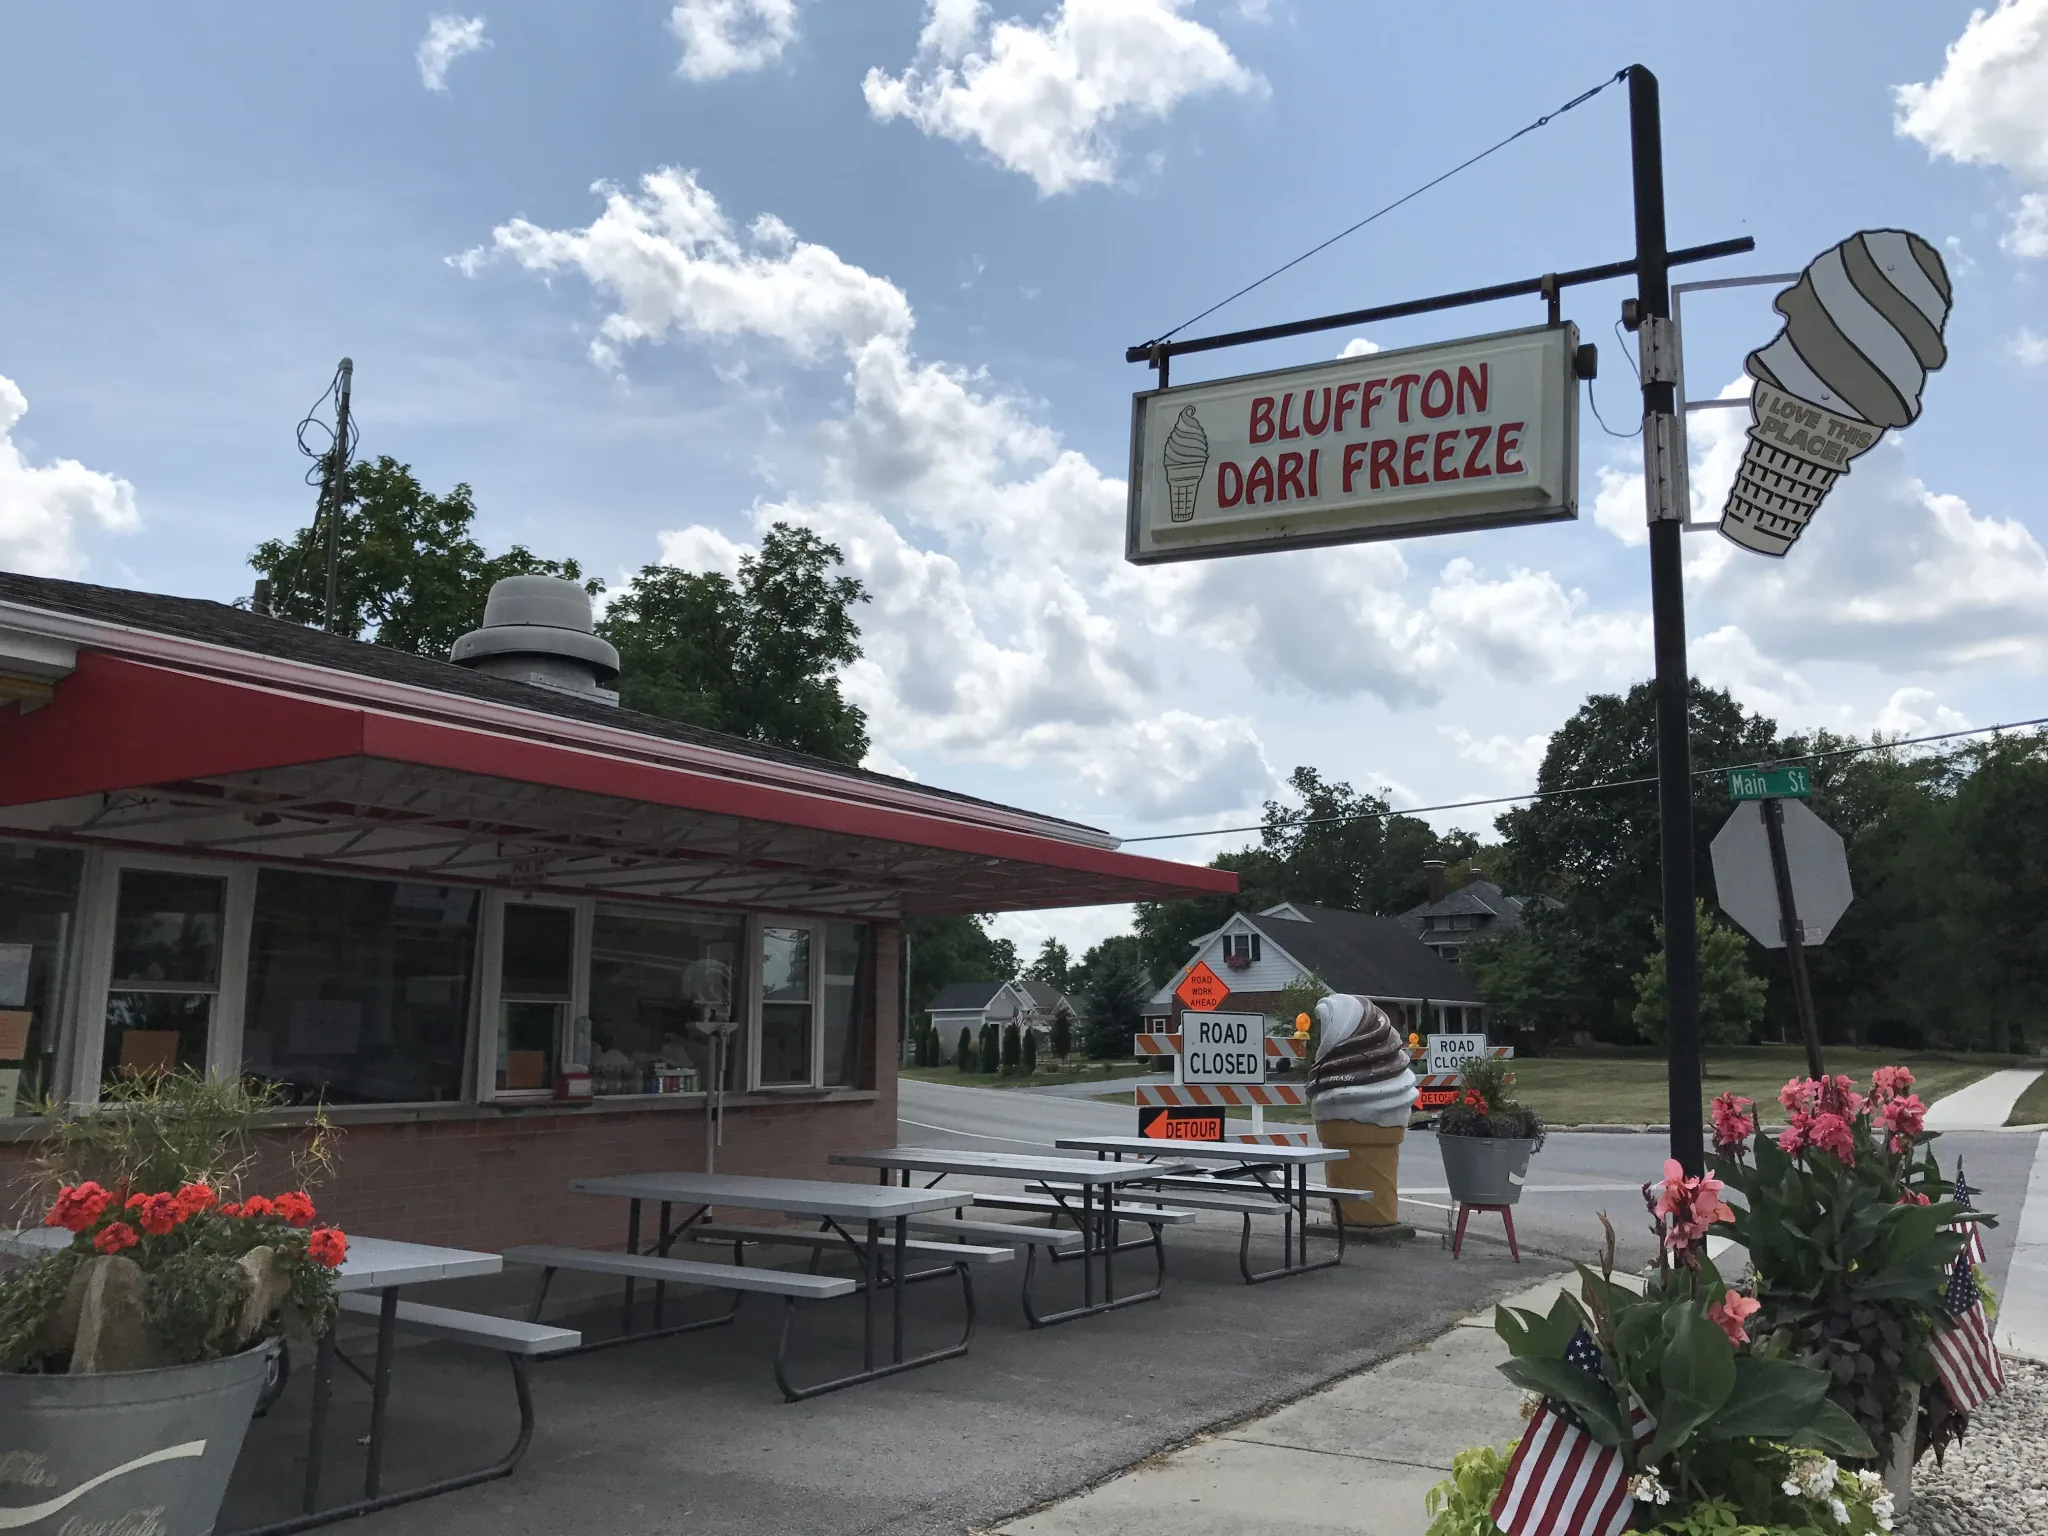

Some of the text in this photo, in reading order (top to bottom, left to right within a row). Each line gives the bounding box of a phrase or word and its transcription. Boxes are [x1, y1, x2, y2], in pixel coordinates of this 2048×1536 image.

[1249, 362, 1489, 444] BLUFFTON
[1757, 392, 1873, 448] I LOVE THIS
[1759, 416, 1849, 465] PLACE!
[1217, 422, 1525, 508] DARI FREEZE
[1731, 771, 1806, 795] Main St
[1191, 976, 1212, 984] ROAD
[1192, 987, 1213, 995] WORK
[1190, 999, 1217, 1007] AHEAD
[1200, 1022, 1247, 1044] ROAD
[1440, 1040, 1475, 1052] ROAD
[1190, 1052, 1258, 1074] CLOSED
[1330, 1074, 1356, 1082] TRASH
[1421, 1093, 1448, 1103] DETO
[1166, 1121, 1217, 1138] DETOUR
